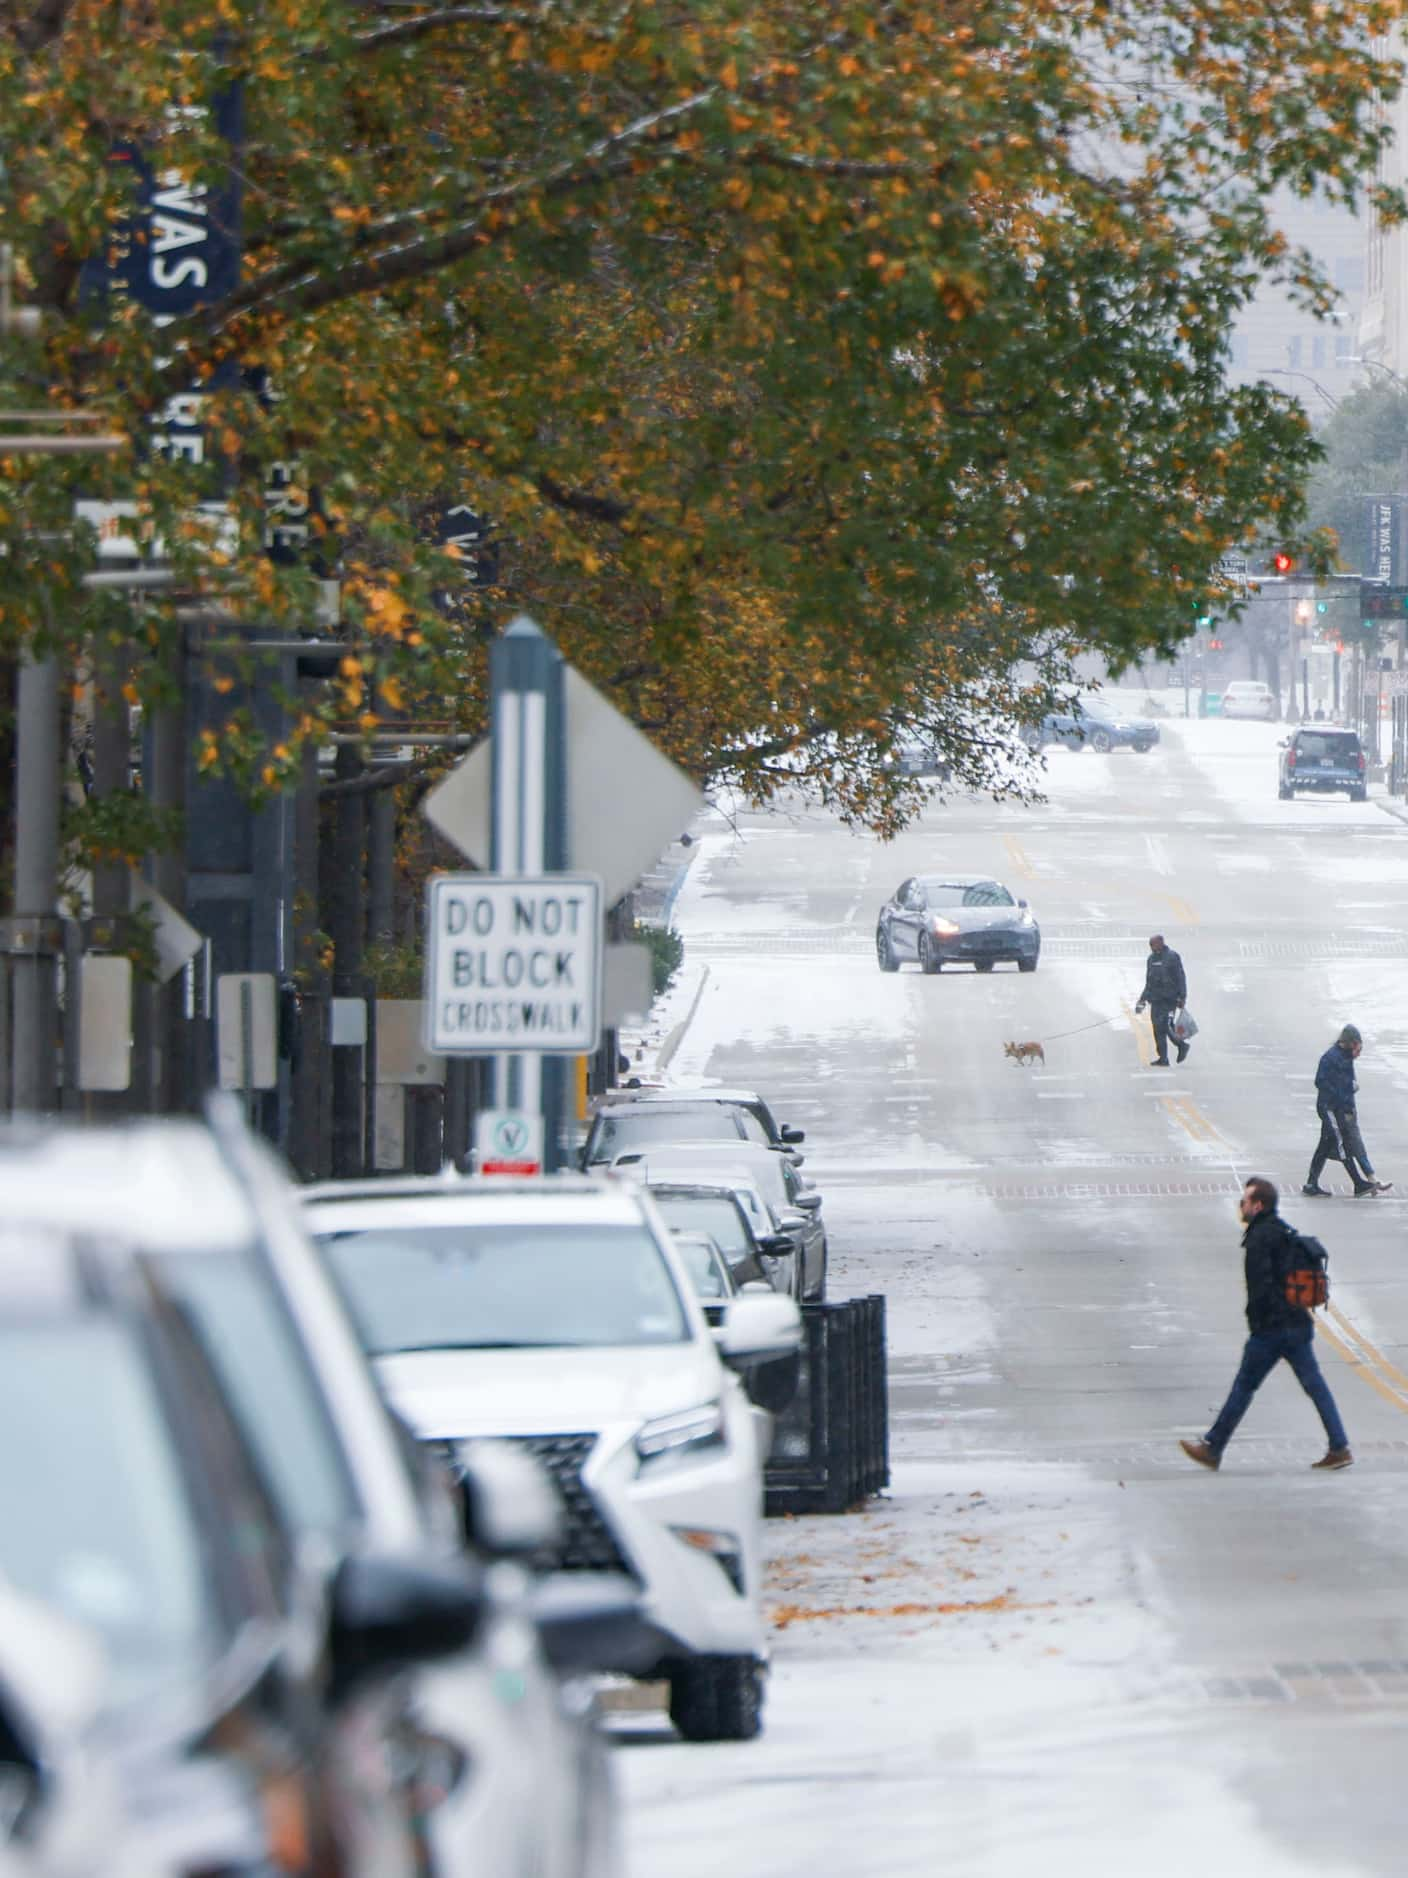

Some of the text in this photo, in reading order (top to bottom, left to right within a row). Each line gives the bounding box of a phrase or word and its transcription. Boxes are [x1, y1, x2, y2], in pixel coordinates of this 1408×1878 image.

[1380, 505, 1392, 525] JFK
[1379, 528, 1391, 553] WAS
[446, 898, 585, 936] DO NOT
[454, 951, 575, 988] BLOCK
[442, 1001, 585, 1033] CROSSWALK
